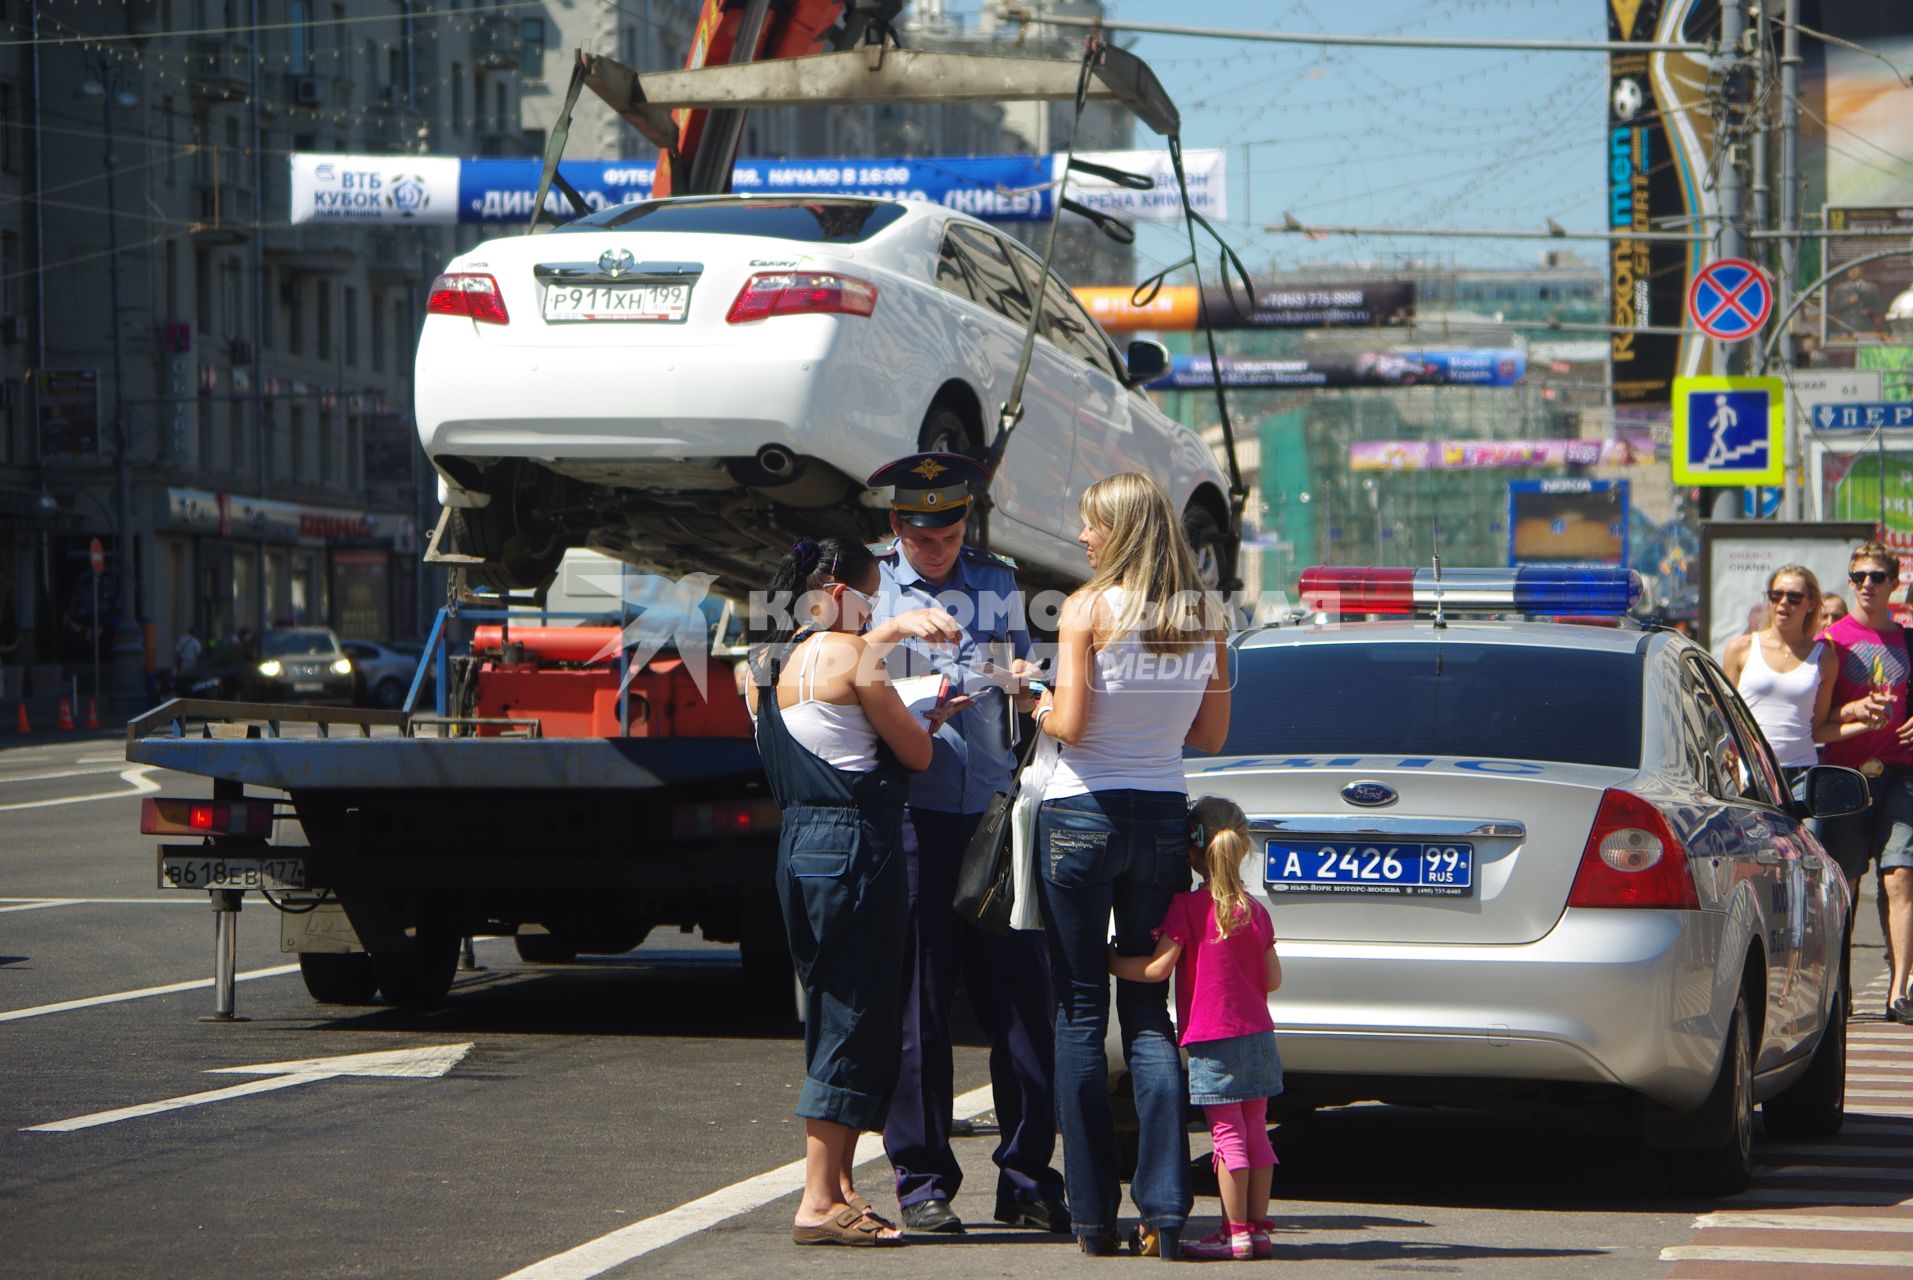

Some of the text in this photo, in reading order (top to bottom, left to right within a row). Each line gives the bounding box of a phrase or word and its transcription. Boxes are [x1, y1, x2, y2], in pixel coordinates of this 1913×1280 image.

[342, 172, 381, 188] ВТБ
[603, 168, 656, 185] ФУТБ
[769, 168, 840, 185] НАЧАЛО
[842, 168, 856, 184] В
[859, 168, 909, 185] 16:00
[1610, 127, 1632, 226] men
[314, 191, 381, 206] КУБОК
[554, 286, 682, 310] Р911ХН 199
[1542, 480, 1592, 493] NOKIA
[1282, 846, 1459, 880] А 2426 99
[169, 860, 297, 885] В618ЕВ 177
[1428, 872, 1454, 883] RUS
